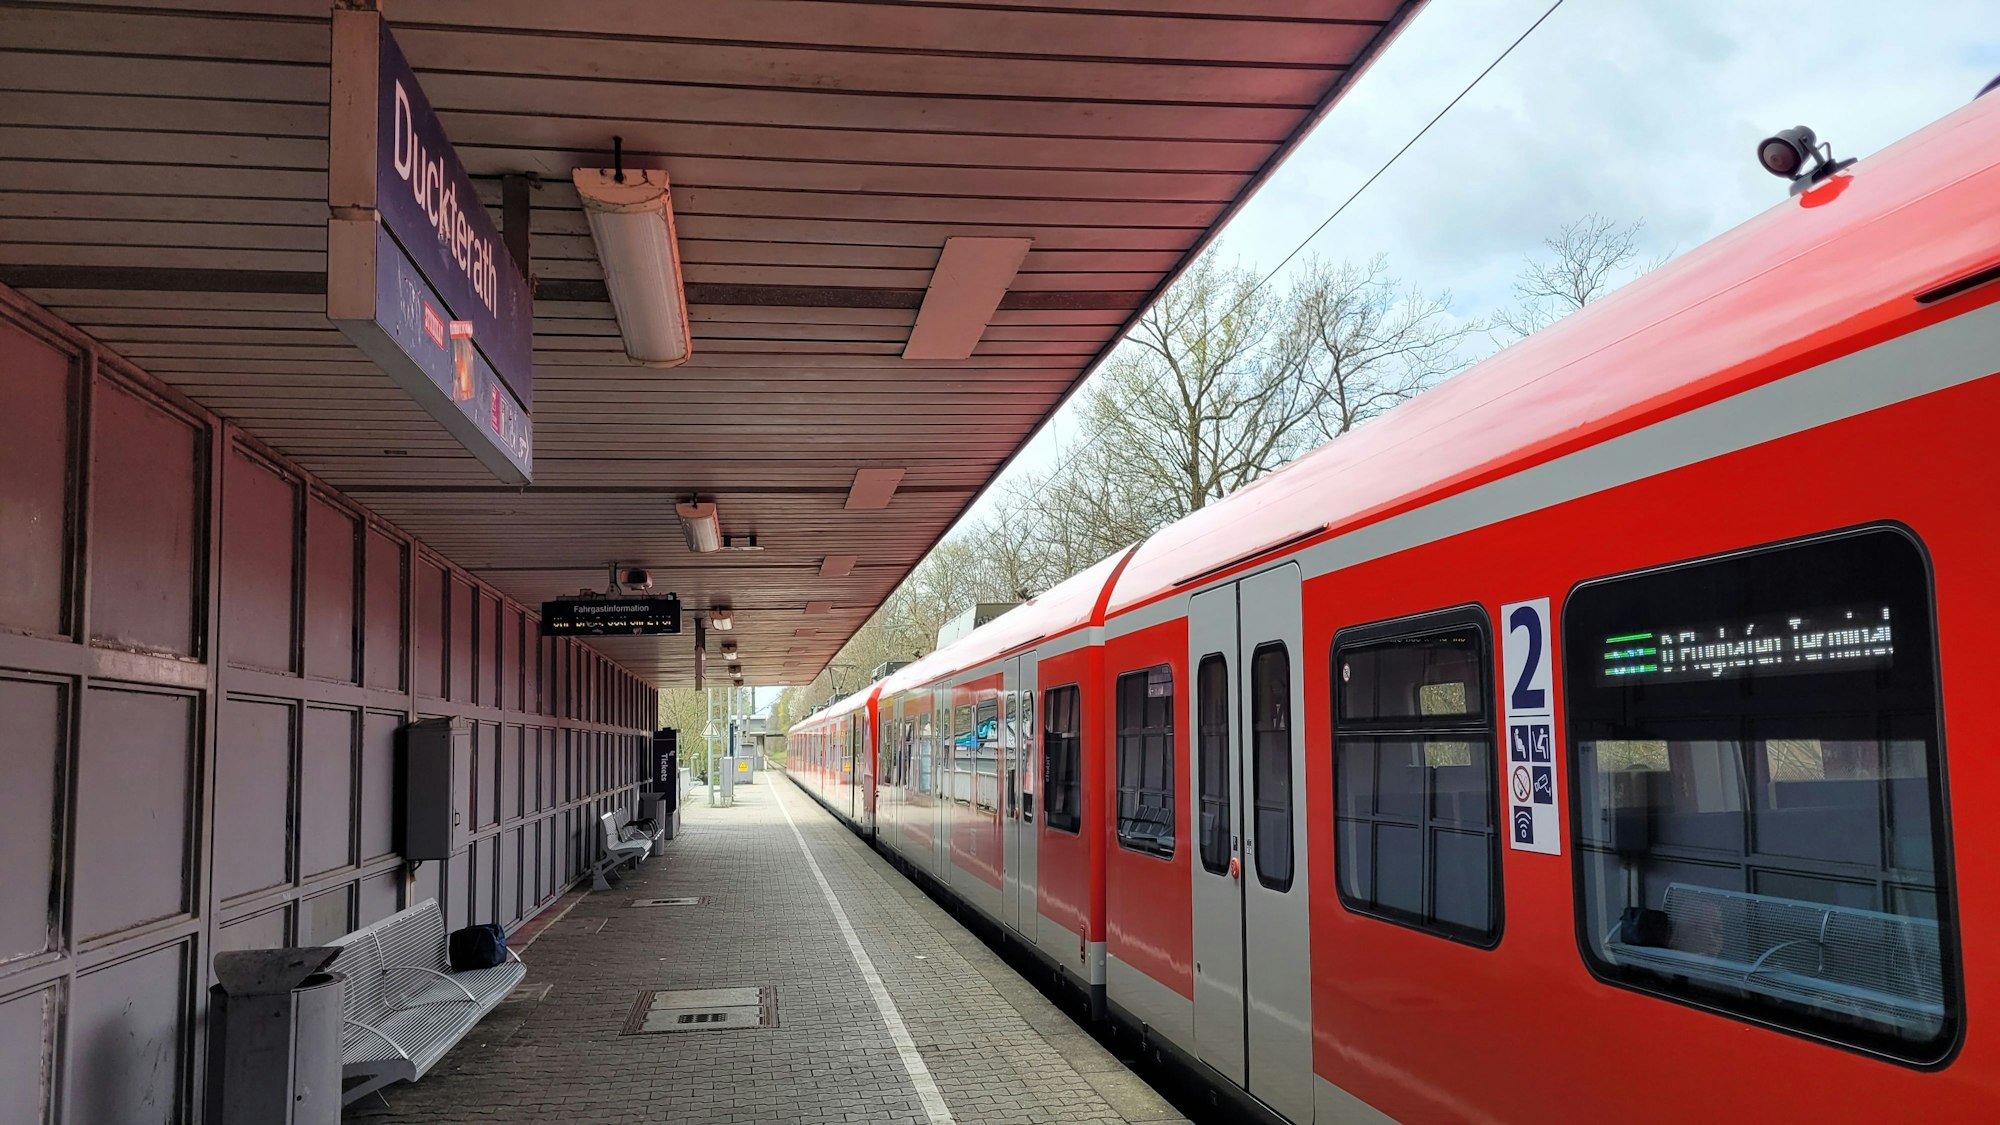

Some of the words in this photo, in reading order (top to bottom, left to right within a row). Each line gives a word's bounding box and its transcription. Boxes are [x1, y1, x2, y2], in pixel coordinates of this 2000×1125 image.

[394, 78, 497, 319] Duckterath
[573, 604, 649, 614] Fahrgastinformation
[1789, 607, 1893, 661] Terminal
[1509, 606, 1545, 709] 2
[660, 753, 669, 781] Tickets
